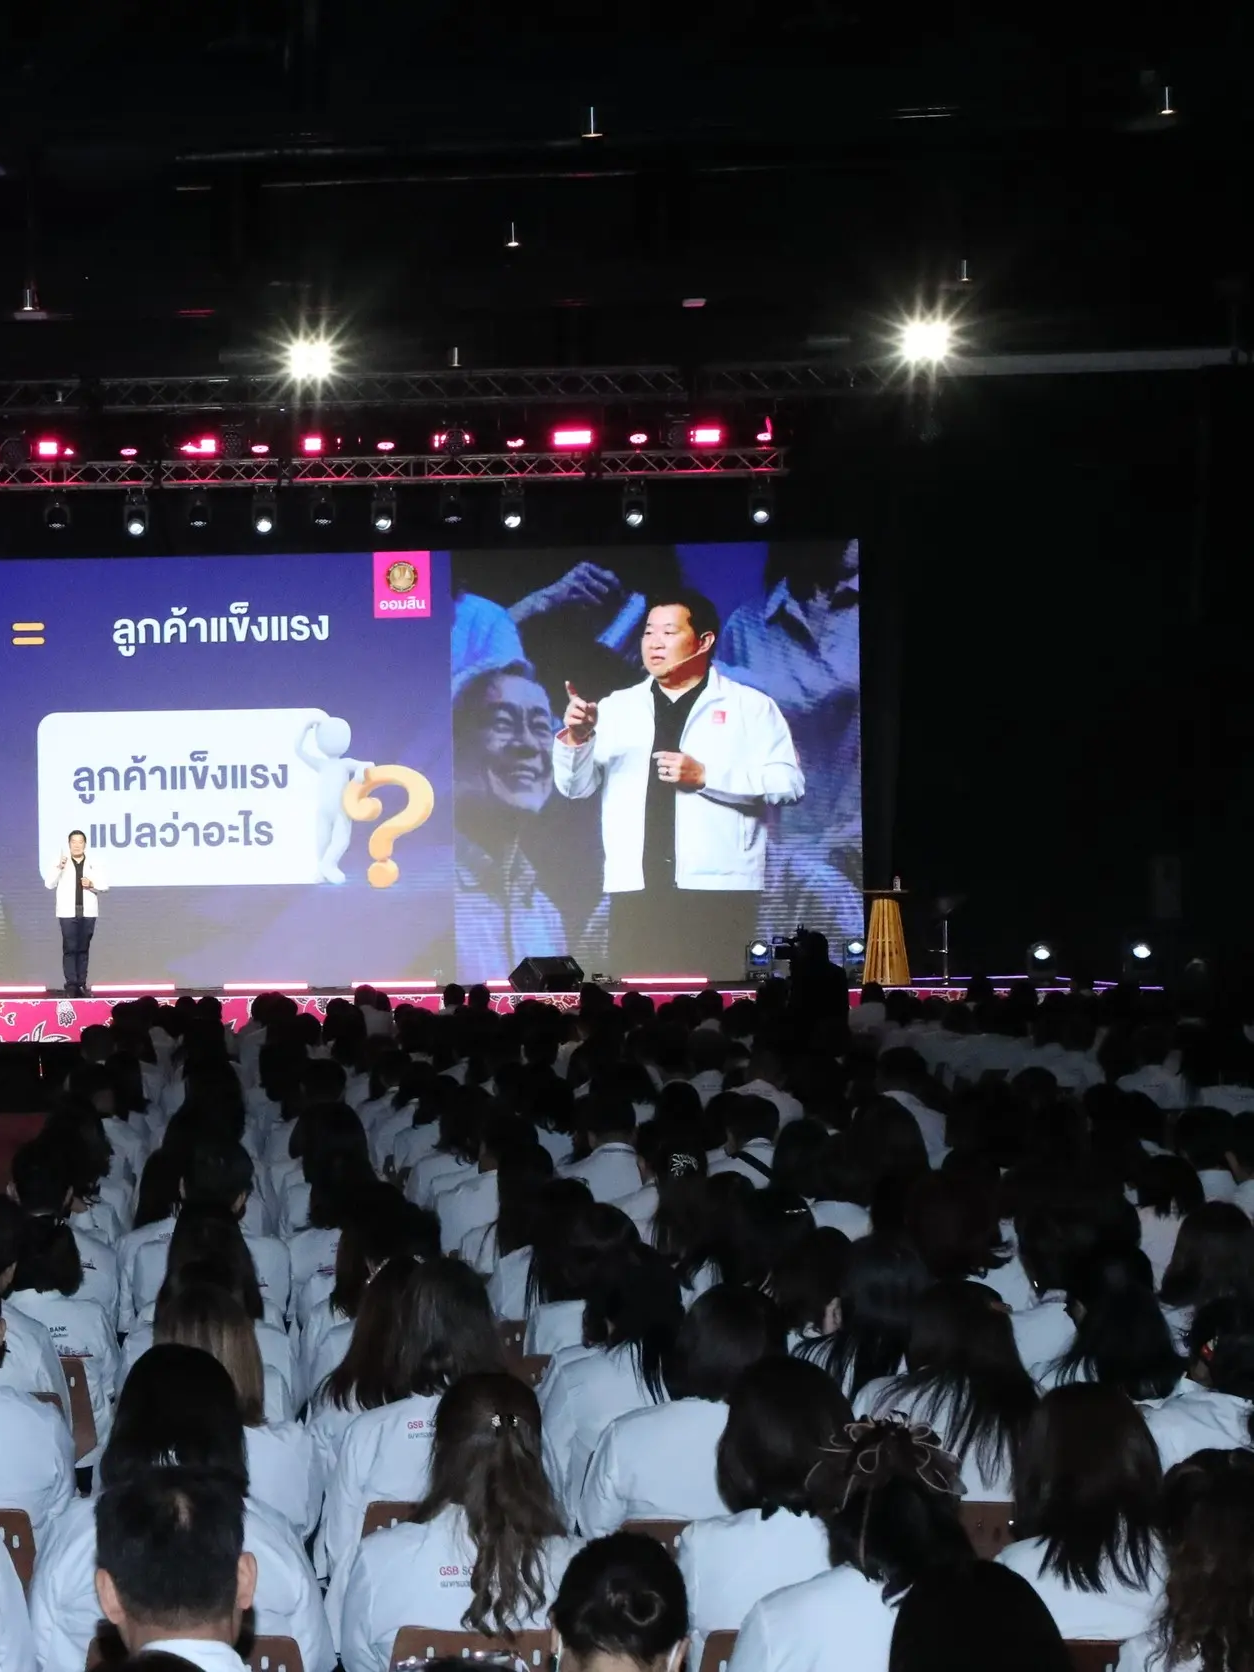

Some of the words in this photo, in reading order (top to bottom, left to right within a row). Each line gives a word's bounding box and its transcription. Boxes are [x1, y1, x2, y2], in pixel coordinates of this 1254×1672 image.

[379, 596, 426, 610] ออมสิน
[112, 602, 329, 657] ลูกค้าแข็งแรง
[73, 750, 288, 804] ลูกค้าแข็งแรง
[90, 810, 274, 848] แปลว่าอะไร
[407, 1420, 424, 1430] GSB
[439, 1565, 459, 1576] GSB
